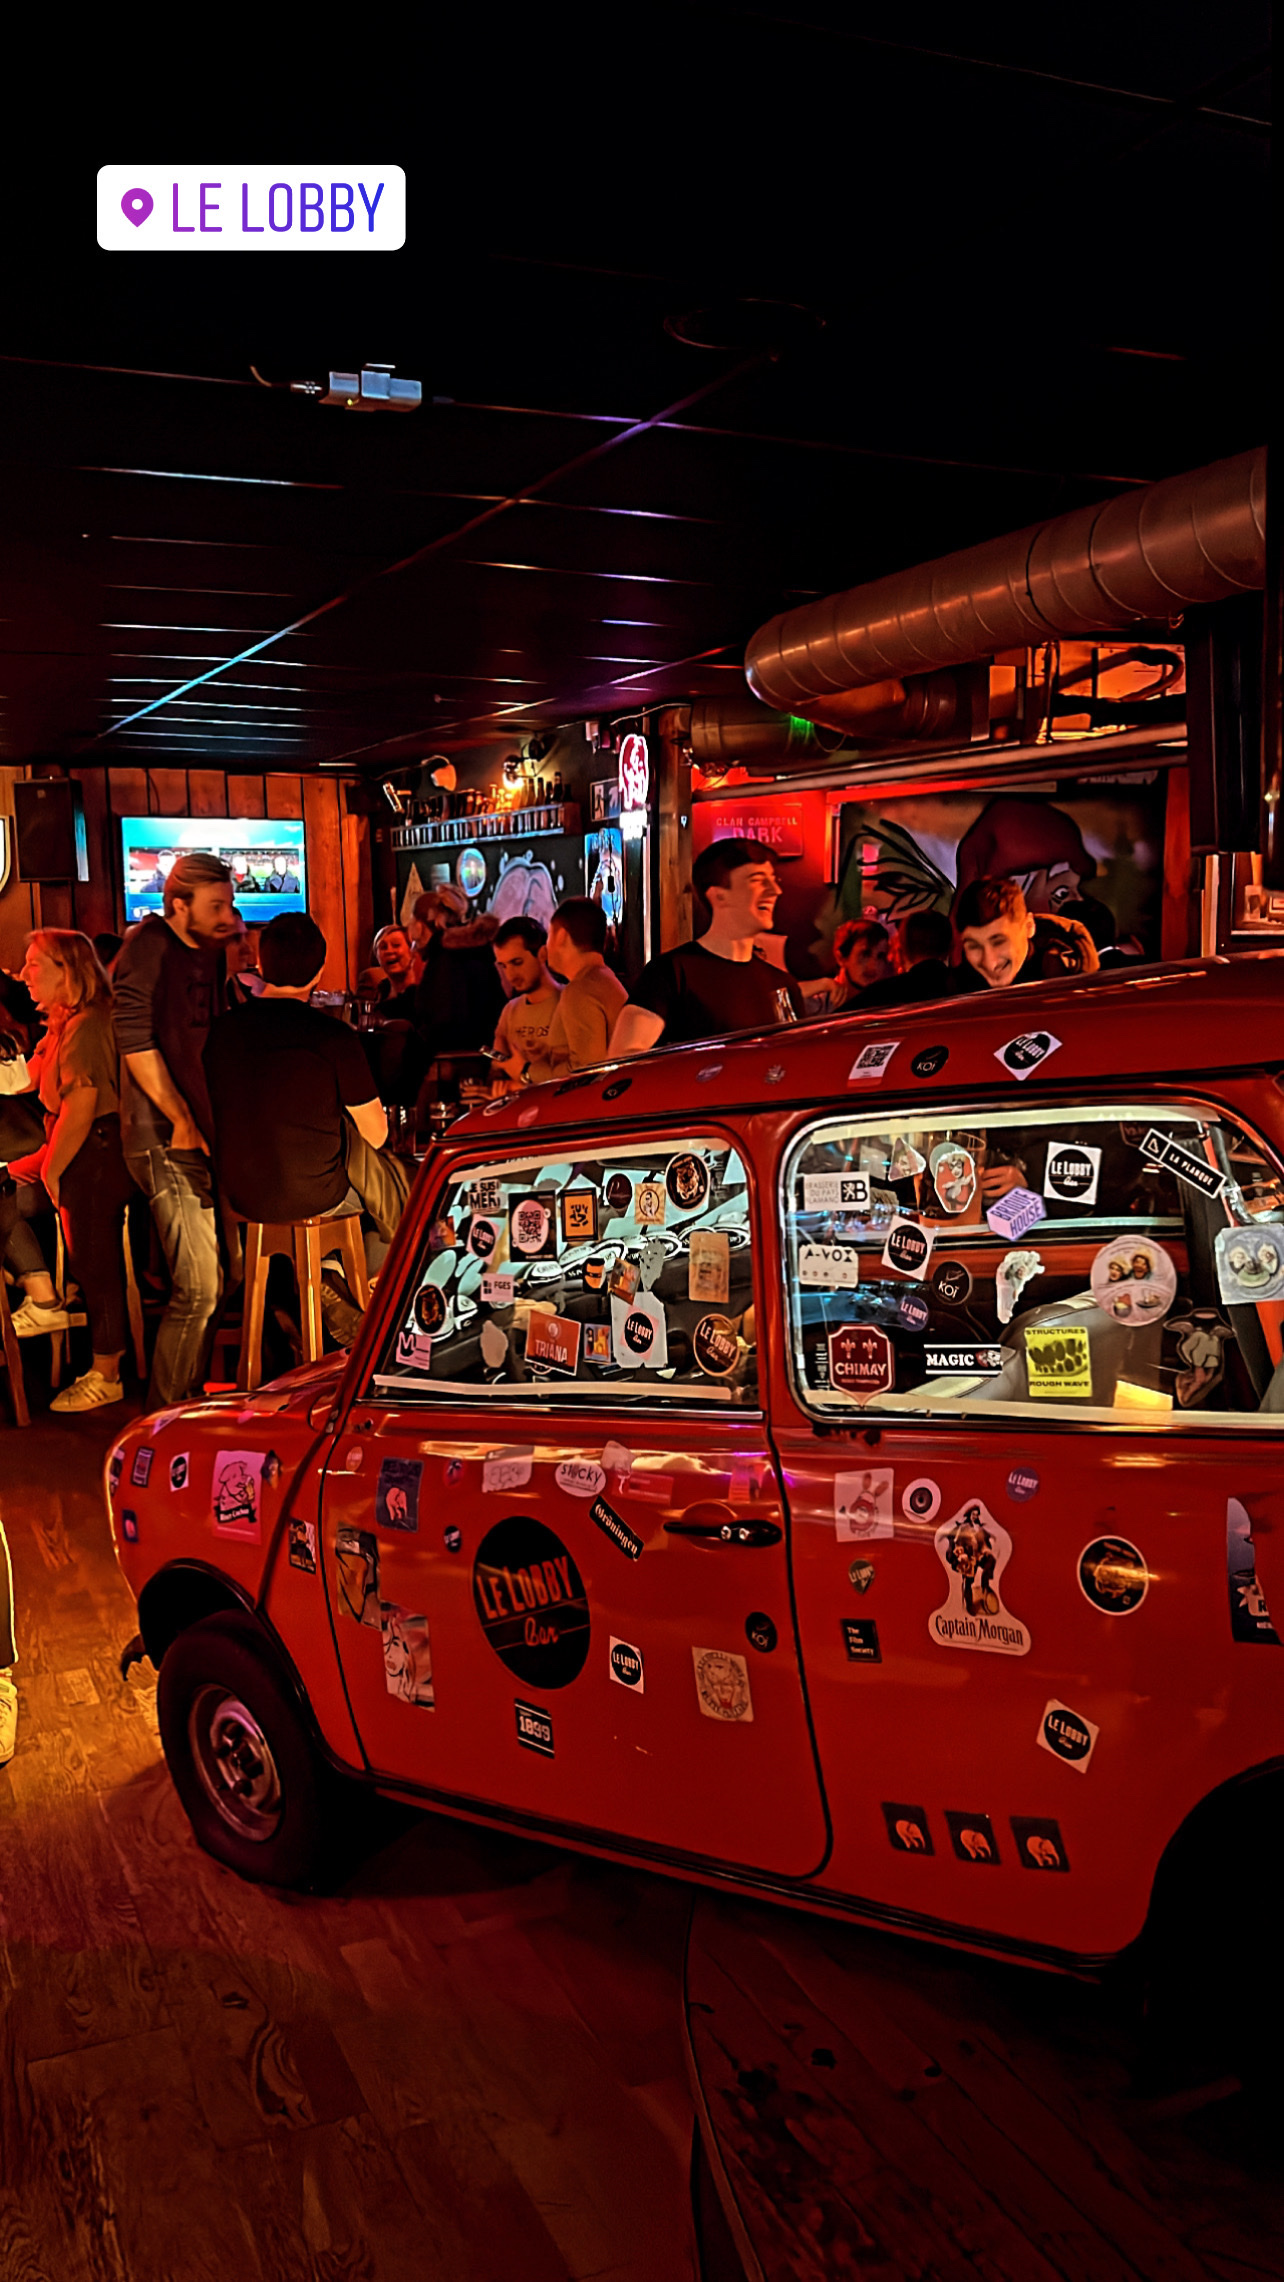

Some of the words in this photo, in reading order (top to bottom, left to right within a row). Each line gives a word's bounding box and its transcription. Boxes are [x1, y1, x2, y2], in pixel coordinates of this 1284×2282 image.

[716, 817, 743, 827] CLAN
[733, 826, 782, 843] DARK
[1051, 1161, 1063, 1175] LE
[1063, 1161, 1092, 1177] LOBBY
[1169, 1153, 1180, 1164] LA
[990, 1191, 1037, 1221] BRIQUE
[1010, 1200, 1041, 1237] HOUSE
[890, 1232, 902, 1247] LE
[901, 1235, 926, 1255] LOBBY
[805, 1248, 853, 1263] A-VOX
[626, 1318, 635, 1332] LE
[634, 1321, 653, 1340] LOBBY
[700, 1322, 711, 1341] LE
[709, 1329, 737, 1358] LOBBY
[535, 1339, 568, 1363] TRIANA
[926, 1353, 975, 1367] MAGIC
[835, 1362, 887, 1376] CHIMAY
[476, 1575, 508, 1619] LE
[502, 1555, 573, 1612] LOBBY
[935, 1614, 977, 1640] Captain
[975, 1618, 1024, 1646] Morgan
[612, 1651, 620, 1664] LE
[519, 1715, 551, 1742] 1899
[1048, 1714, 1060, 1732] LE
[1060, 1721, 1089, 1747] LOBBY
